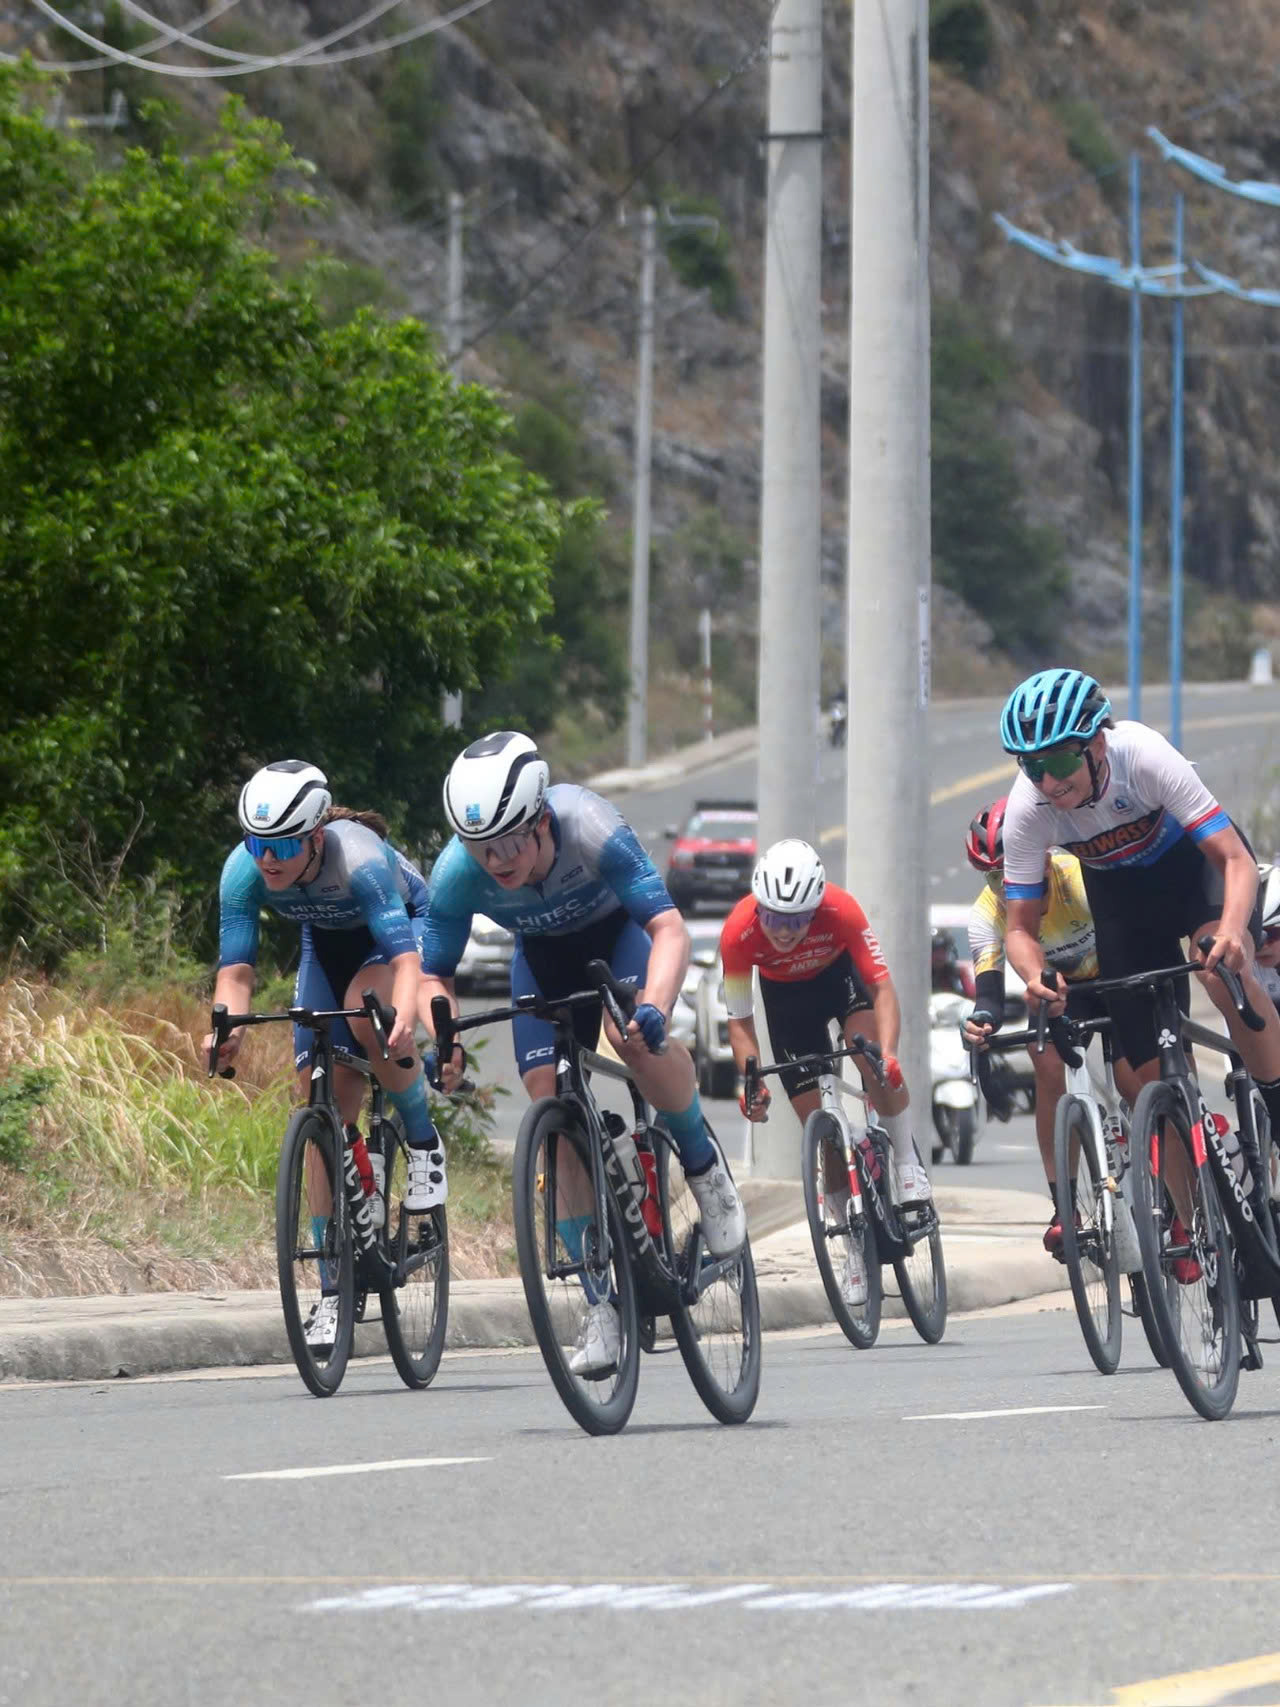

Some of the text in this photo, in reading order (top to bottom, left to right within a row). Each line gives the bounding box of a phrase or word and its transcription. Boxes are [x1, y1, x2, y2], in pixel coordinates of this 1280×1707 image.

[289, 903, 341, 913] HITEC
[516, 898, 583, 928] HITEC
[862, 927, 888, 969] ANTA
[1198, 1095, 1254, 1222] COLNAGO
